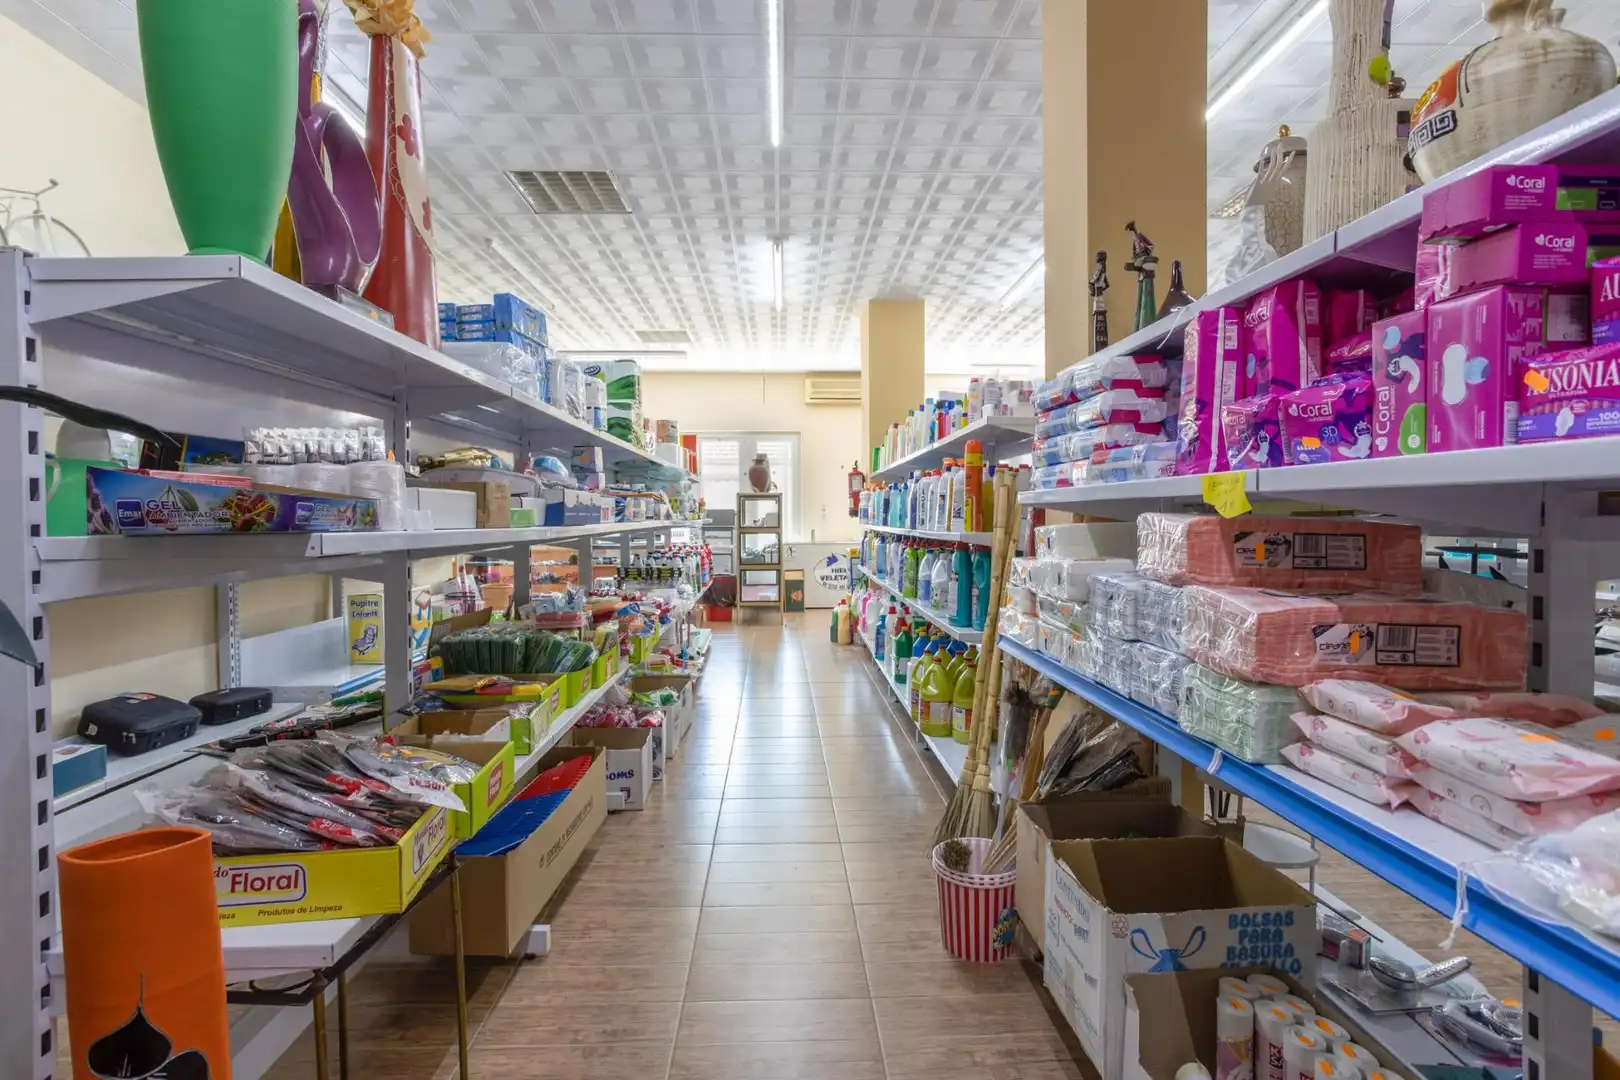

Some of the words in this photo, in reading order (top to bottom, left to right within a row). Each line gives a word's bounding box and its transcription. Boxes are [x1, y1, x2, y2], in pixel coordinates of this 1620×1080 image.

[1516, 176, 1546, 189] Coral
[1545, 235, 1575, 248] Coral
[1298, 400, 1333, 417] Coral
[1376, 386, 1390, 434] Coral
[1322, 426, 1338, 437] 3D
[146, 500, 182, 510] GEL
[149, 511, 229, 520] AMBIENTADOR
[351, 600, 379, 608] Pupitre
[230, 869, 300, 894] Floral
[258, 907, 295, 917] Produtos
[297, 906, 307, 914] de
[309, 904, 343, 914] Limpeza
[1228, 911, 1294, 929] BOLSAS
[1238, 927, 1283, 945] PARA
[1227, 943, 1294, 961] BASURA
